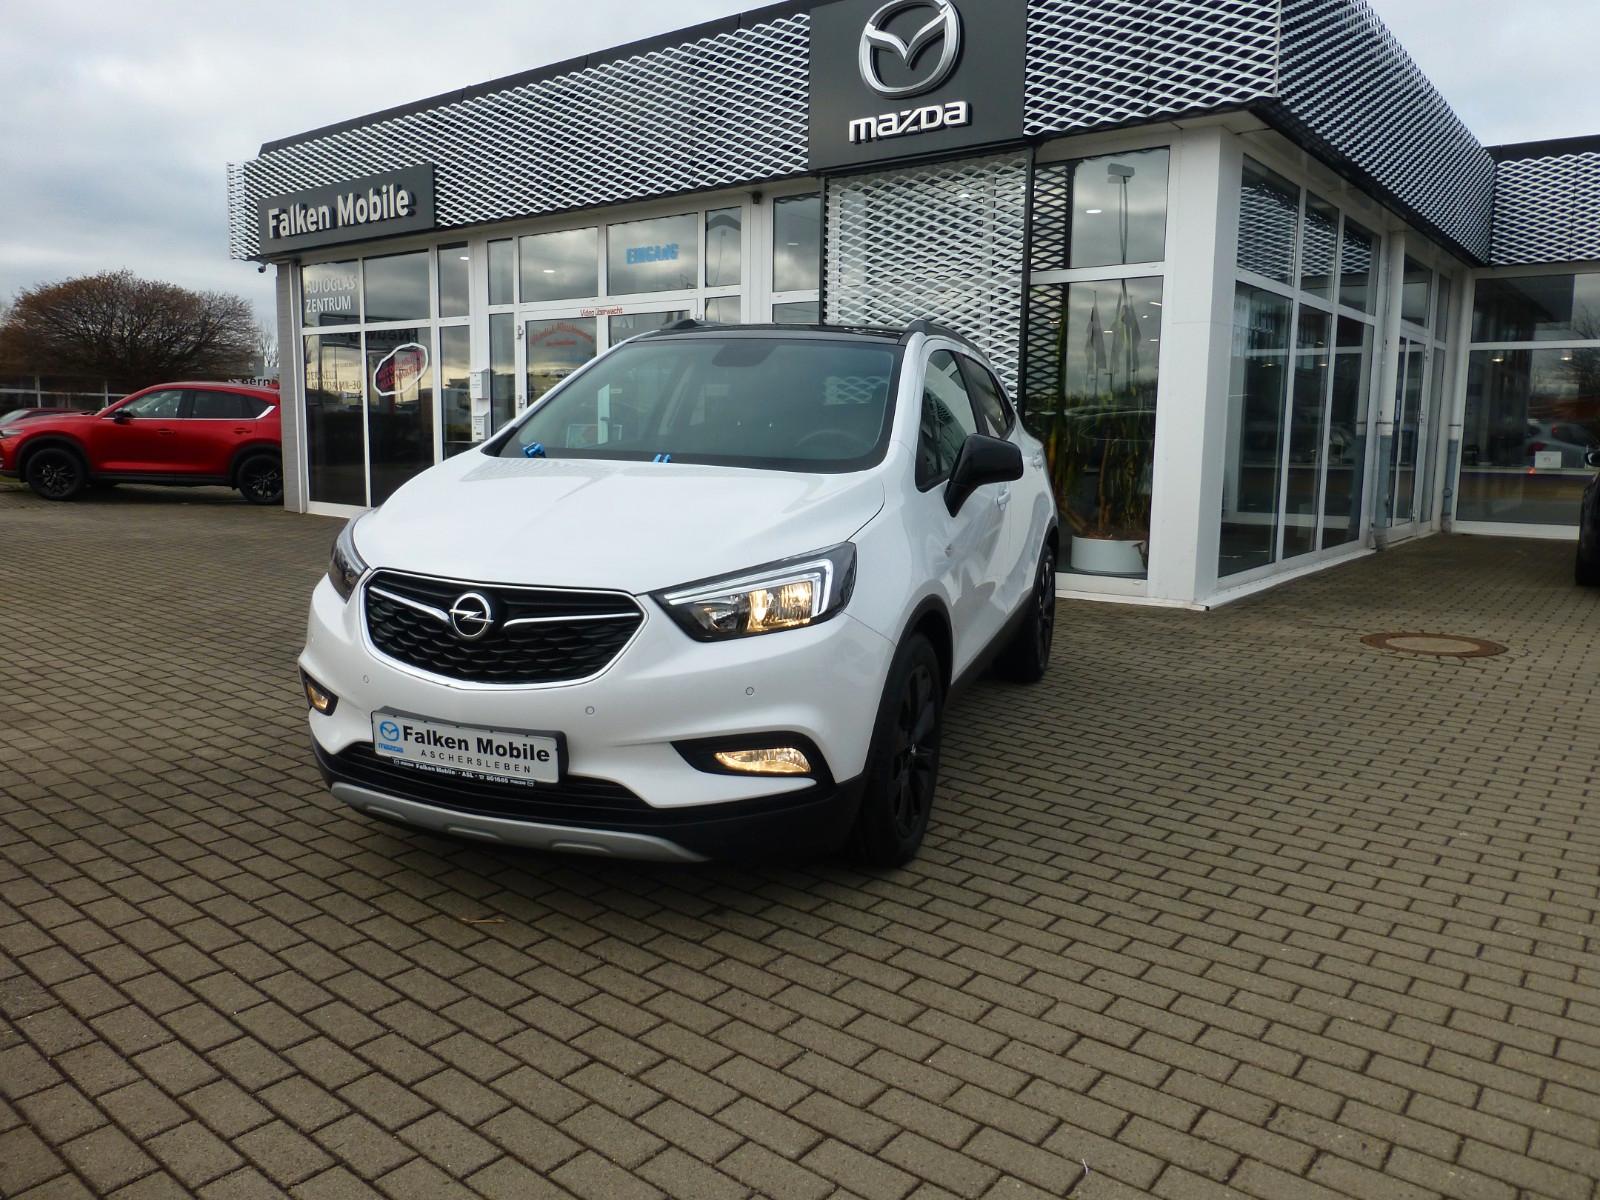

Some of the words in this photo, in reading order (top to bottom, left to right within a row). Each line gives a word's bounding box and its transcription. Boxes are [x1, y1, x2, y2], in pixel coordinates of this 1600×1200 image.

[848, 100, 967, 142] mazda
[267, 202, 331, 239] Falken
[337, 183, 410, 227] Mobile
[305, 276, 357, 294] AUTOGLAS
[306, 296, 352, 313] ZENTRUM
[402, 725, 470, 752] Falken
[476, 737, 550, 762] Mobile
[415, 763, 436, 772] Falken
[421, 749, 531, 774] ASCHERSLEBEN
